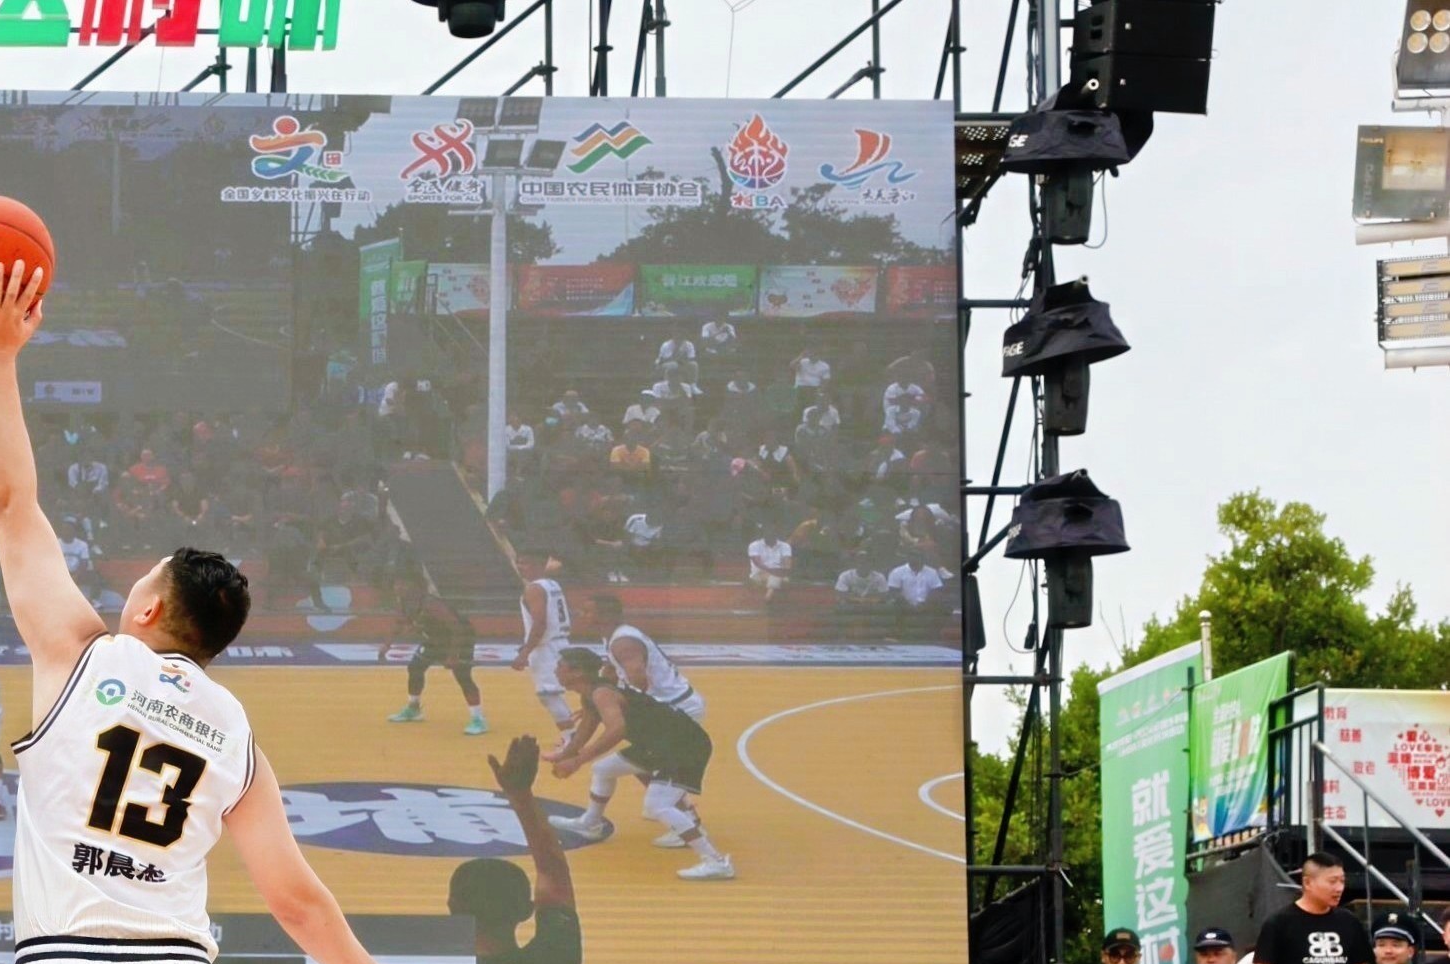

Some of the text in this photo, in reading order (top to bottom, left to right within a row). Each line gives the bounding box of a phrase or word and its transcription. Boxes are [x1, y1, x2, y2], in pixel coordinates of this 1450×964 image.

[223, 188, 370, 201] 全国乡村文化振兴在行动
[521, 181, 700, 197] 中国农民体育协会
[127, 703, 223, 753] HENAN RURAL COMMERCIAL BANK
[130, 690, 227, 746] 河南农商银行
[86, 721, 208, 849] 13
